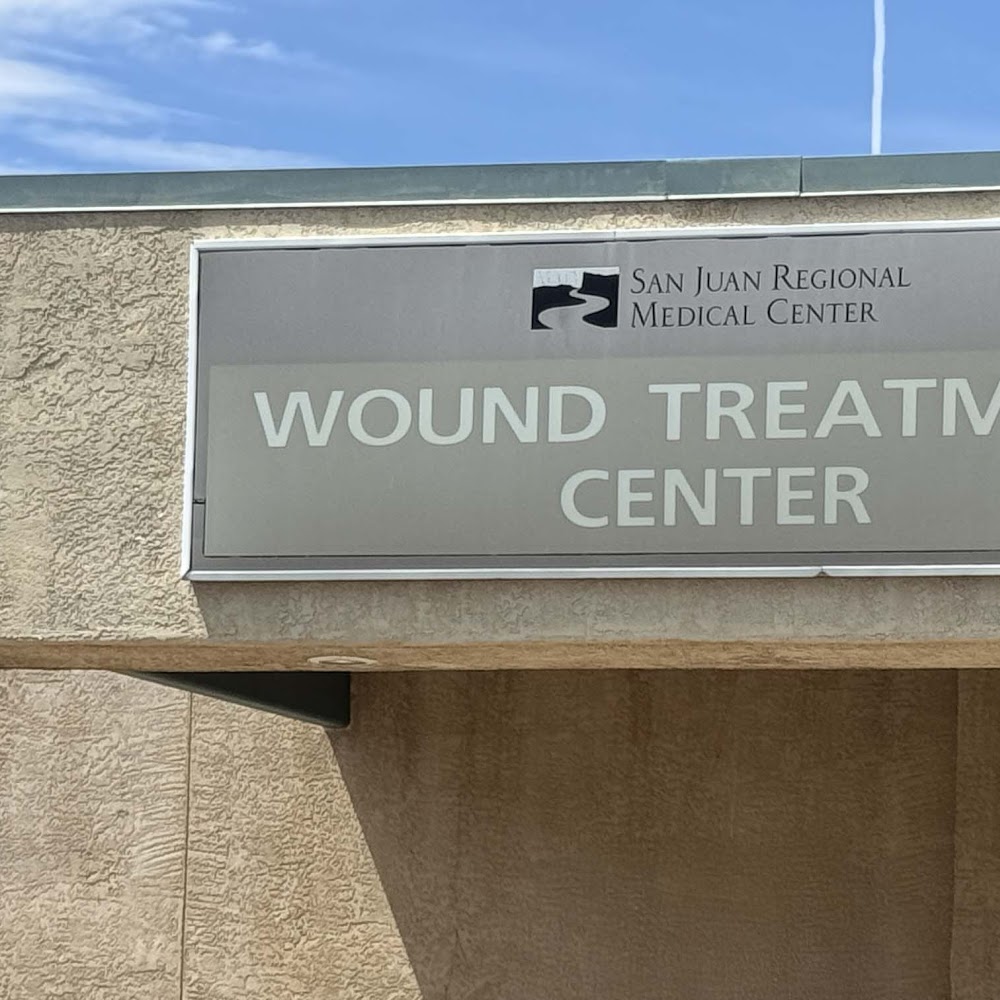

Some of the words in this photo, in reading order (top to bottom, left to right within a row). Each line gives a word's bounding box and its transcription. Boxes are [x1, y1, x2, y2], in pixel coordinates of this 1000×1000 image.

[630, 267, 684, 294] SAN
[693, 266, 762, 297] JUAN
[772, 263, 912, 291] REGIONAL
[630, 302, 756, 328] MEDICAL
[766, 298, 879, 326] CENTER
[253, 385, 606, 449] WOUND
[560, 465, 873, 528] CENTER
